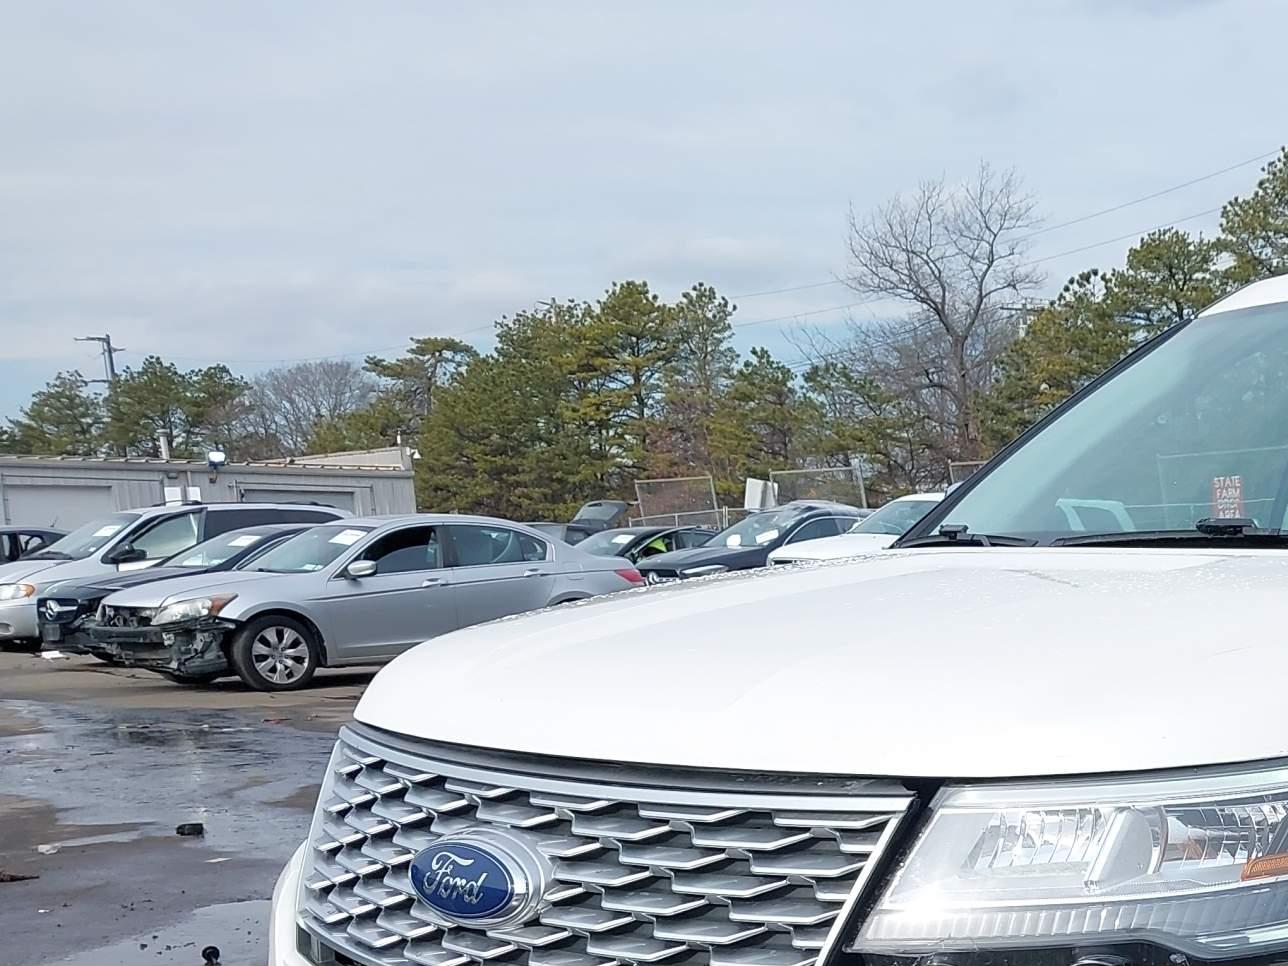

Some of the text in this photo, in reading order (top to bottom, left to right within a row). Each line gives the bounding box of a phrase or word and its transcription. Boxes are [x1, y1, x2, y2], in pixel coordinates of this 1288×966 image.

[1213, 475, 1241, 489] STATE
[1215, 488, 1241, 499] FARM
[422, 851, 488, 905] Ford
